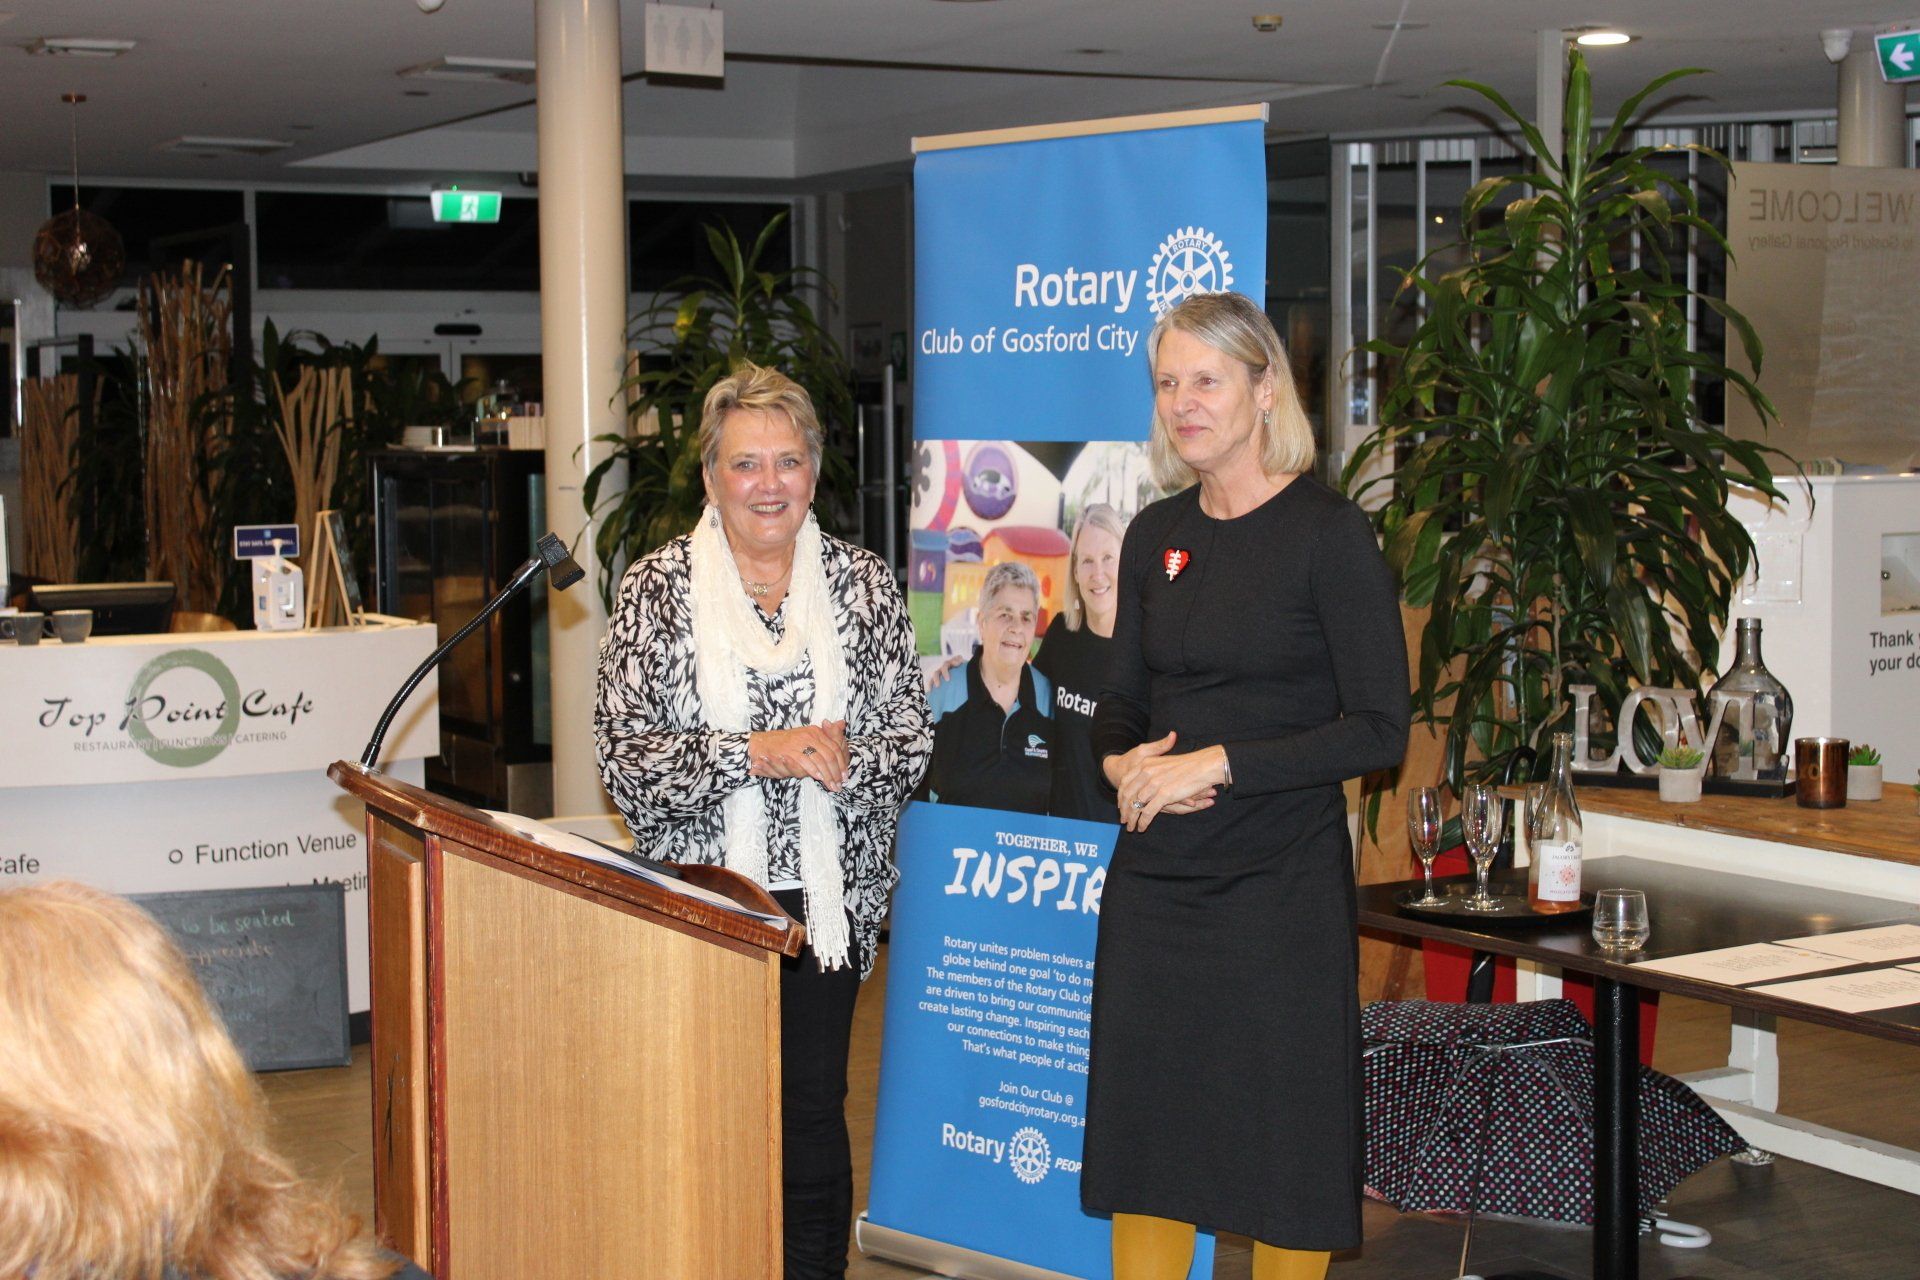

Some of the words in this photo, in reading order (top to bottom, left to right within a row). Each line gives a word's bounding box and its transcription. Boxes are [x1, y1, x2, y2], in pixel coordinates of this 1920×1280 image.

[1172, 238, 1208, 252] ROTARY
[1015, 263, 1137, 313] Rotary
[922, 328, 963, 354] Club
[971, 326, 996, 353] of
[1002, 325, 1089, 353] Gosford
[1097, 323, 1138, 356] City
[1869, 629, 1914, 648] Thank
[1870, 657, 1902, 676] your
[39, 697, 106, 737] Top
[119, 695, 228, 730] Point
[242, 689, 314, 724] Cafe
[1057, 686, 1097, 718] Rotar
[235, 731, 288, 744] CATERING
[196, 839, 289, 865] Function
[297, 831, 357, 854] Venue
[996, 832, 1072, 857] TOGETHER,
[1074, 842, 1098, 858] WE
[944, 848, 1107, 916] INSPIR
[943, 952, 971, 967] globe
[974, 957, 1006, 972] behind
[1009, 965, 1027, 976] one
[1030, 964, 1050, 980] goal
[1068, 972, 1081, 985] do
[944, 935, 977, 953] Rotary
[979, 940, 1008, 955] unites
[1011, 948, 1050, 962] problem
[1052, 953, 1083, 969] solvers
[926, 966, 944, 980] The
[948, 971, 992, 987] members
[994, 977, 1005, 989] of
[1007, 979, 1023, 992] the
[1026, 983, 1057, 1000] Rotary
[1059, 988, 1080, 1004] Club
[1082, 993, 1093, 1005] of
[926, 984, 942, 996] are
[944, 988, 975, 1001] driven
[978, 991, 988, 1003] to
[991, 994, 1015, 1011] bring
[1018, 1002, 1034, 1012] our
[1036, 1004, 1091, 1022] communitie
[919, 1000, 948, 1014] create
[951, 1004, 983, 1021] lasting
[986, 1009, 1022, 1027] change.
[1025, 1016, 1065, 1037] Inspiring
[1068, 1026, 1090, 1040] each
[947, 1022, 964, 1032] our
[967, 1025, 1022, 1044] connections
[1025, 1035, 1035, 1047] to
[1038, 1037, 1063, 1052] make
[1066, 1042, 1090, 1060] thing
[993, 1046, 1017, 1061] what
[1019, 1052, 1052, 1068] people
[1055, 1057, 1066, 1069] of
[1067, 1061, 1089, 1075] actio
[999, 1080, 1018, 1095] Join
[1021, 1084, 1039, 1098] Our
[1041, 1089, 1063, 1105] Club
[1065, 1094, 1074, 1106] @
[979, 1095, 1086, 1127] gosfordcityrotary.org.a
[942, 1122, 1005, 1164] Rotary
[1055, 1157, 1082, 1173] PEOP
